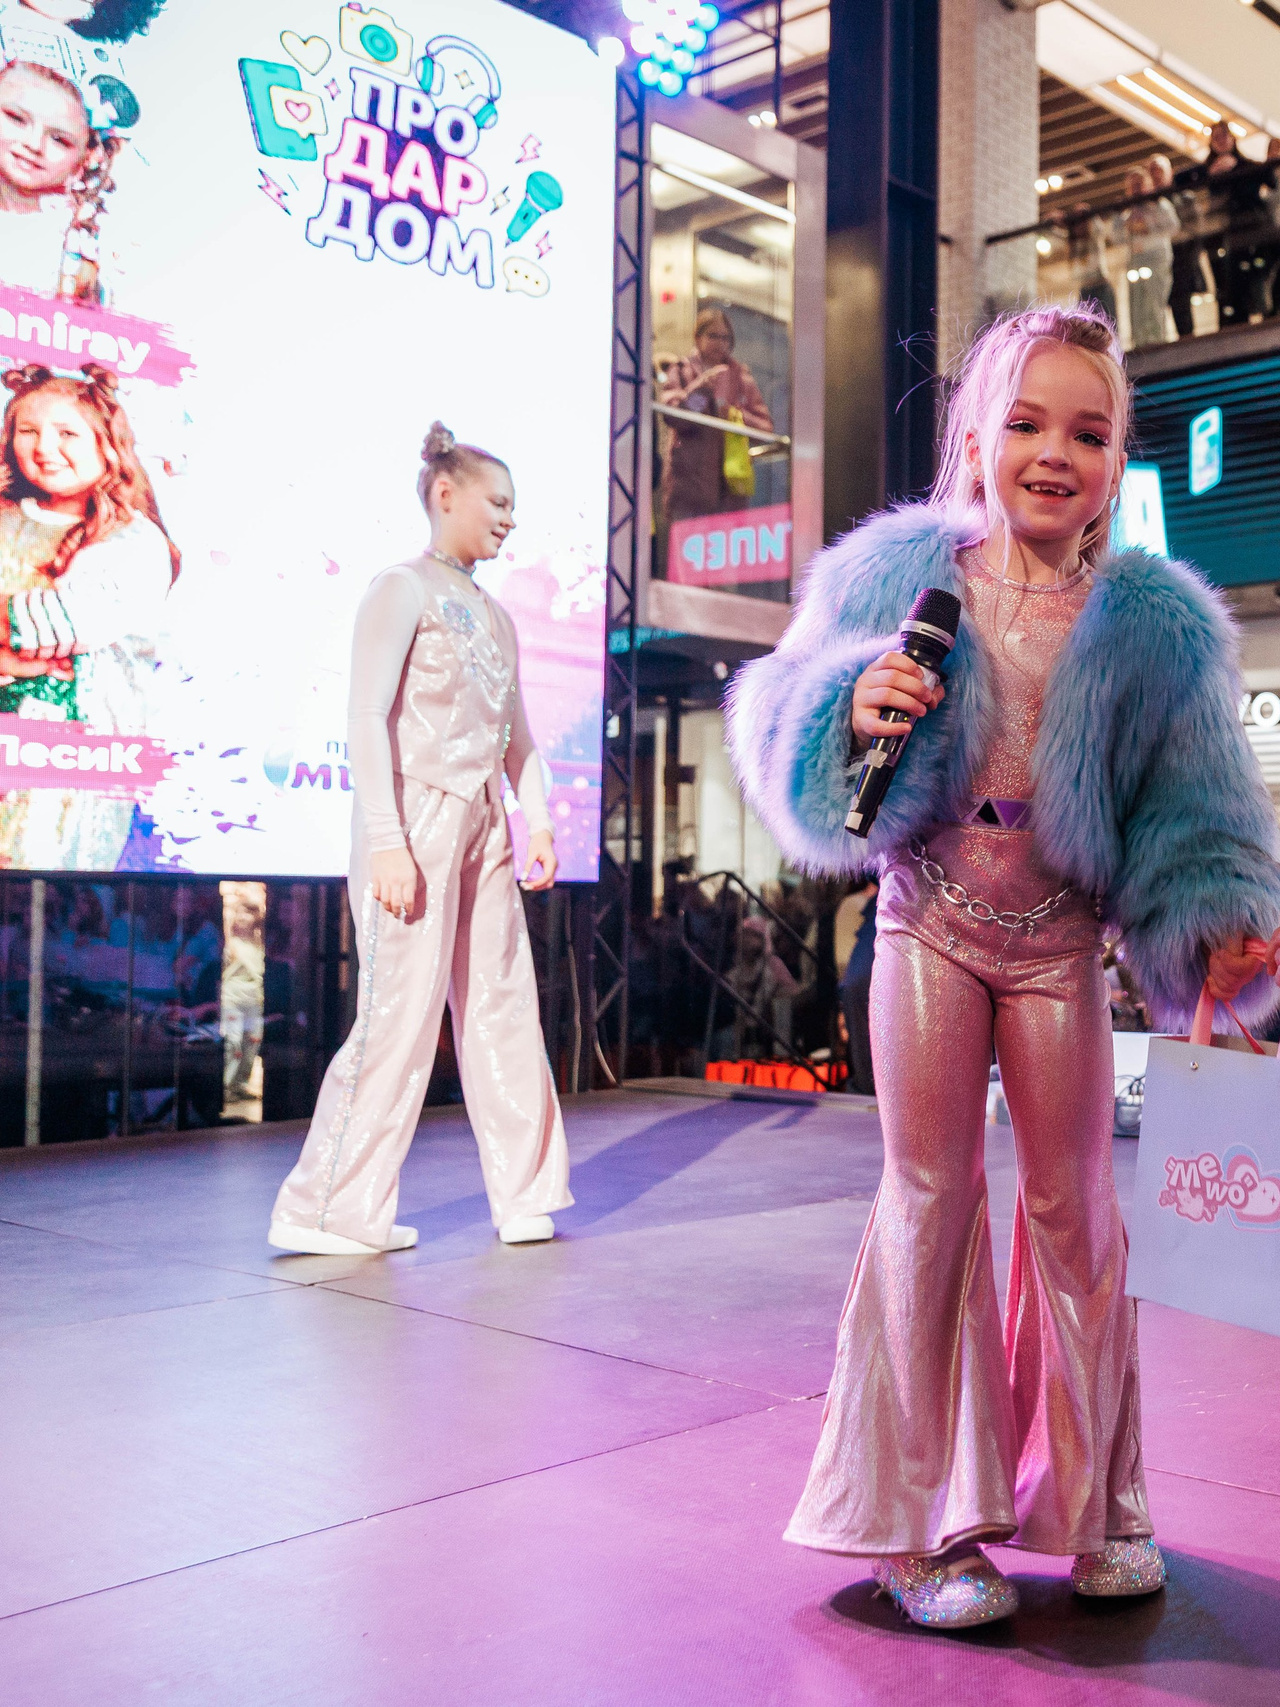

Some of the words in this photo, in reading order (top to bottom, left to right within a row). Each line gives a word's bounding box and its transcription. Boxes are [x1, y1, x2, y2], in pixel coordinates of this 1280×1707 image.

[349, 66, 480, 158] ПРО
[323, 117, 488, 216] ДАР
[305, 180, 495, 290] ДОМ
